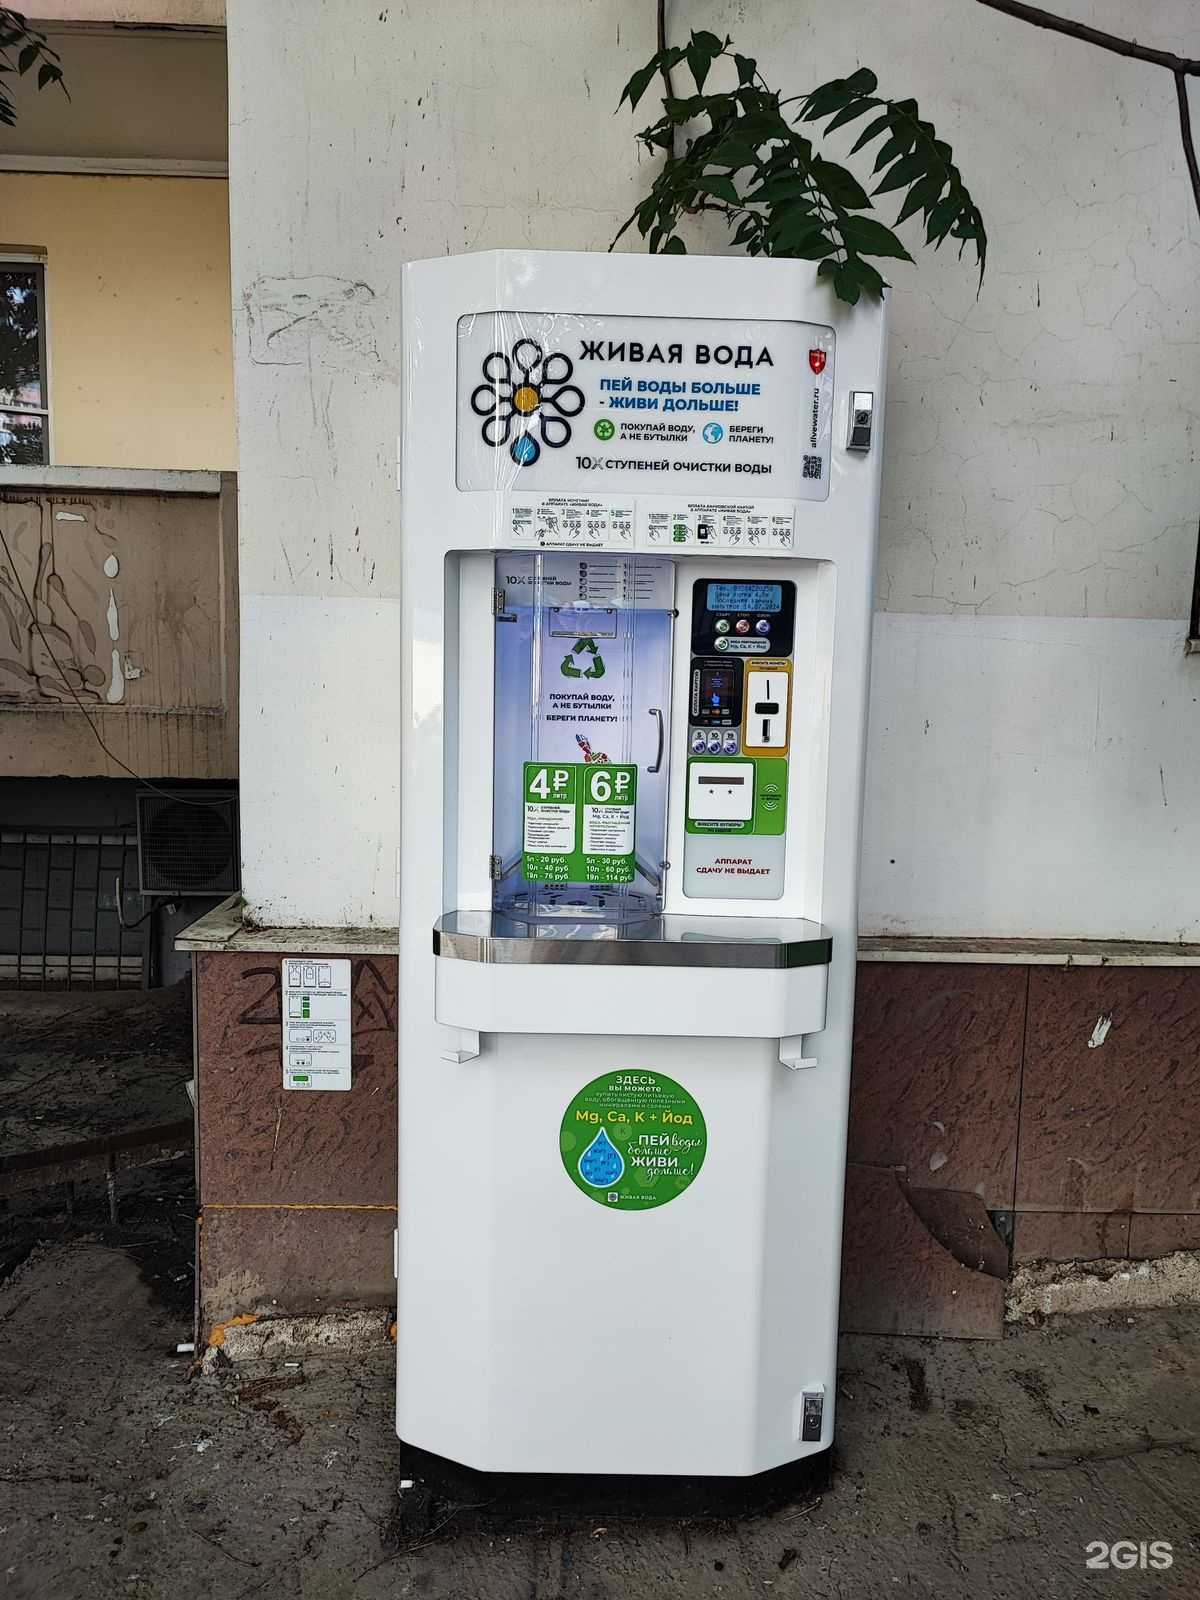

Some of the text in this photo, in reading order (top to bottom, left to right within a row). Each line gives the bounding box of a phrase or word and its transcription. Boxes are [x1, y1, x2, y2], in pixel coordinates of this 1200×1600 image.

[579, 340, 774, 368] ЖИВАЯ ВОДА
[600, 377, 761, 395] ПЕЙ ВОДЫ БОЛЬШЕ
[609, 397, 658, 410] ЖИВИ
[663, 399, 739, 412] ДОЛЬШЕ!
[620, 422, 695, 434] ПОКУПАЙ ВОДУ,
[729, 425, 764, 434] БЕРЕГИ
[620, 433, 627, 441] А
[643, 434, 688, 442] БУТЫЛКИ
[728, 435, 774, 444] ПЛАНЕТУ!
[605, 459, 670, 472] СТУПЕНЕЙ
[673, 463, 731, 473] ОЧИСТКИ
[735, 463, 772, 474] ВОДЫ
[527, 863, 538, 871] 10л
[616, 1075, 656, 1085] ЗДЕСЬ
[576, 1110, 603, 1124] Mg,
[607, 1111, 630, 1123] Ca,
[662, 1110, 693, 1125] Йод
[628, 1142, 672, 1155] больше
[639, 1133, 702, 1153] ПЕЙ воды
[631, 1157, 678, 1167] ЖИВИ
